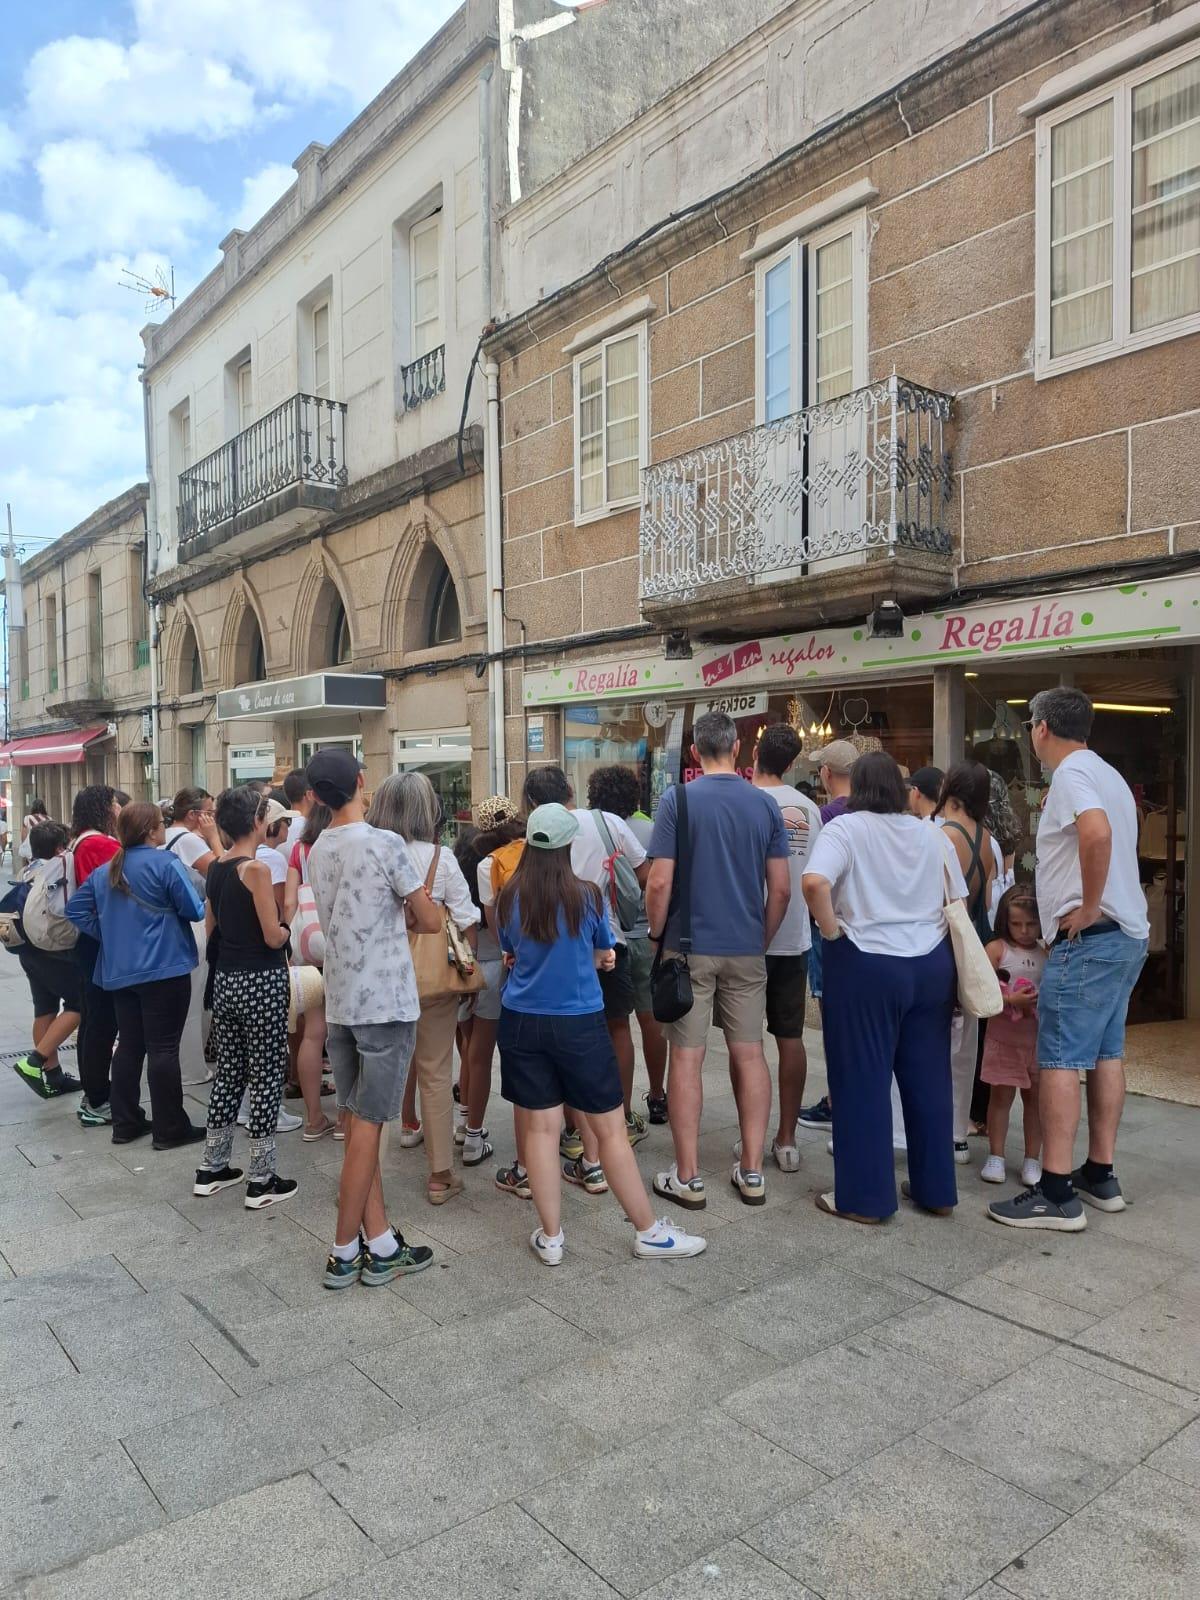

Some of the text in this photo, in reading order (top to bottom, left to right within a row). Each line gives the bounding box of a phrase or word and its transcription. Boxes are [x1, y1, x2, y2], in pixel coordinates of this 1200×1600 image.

[939, 602, 1075, 651] Regalía
[769, 635, 836, 675] regalos
[574, 663, 638, 694] Regalía
